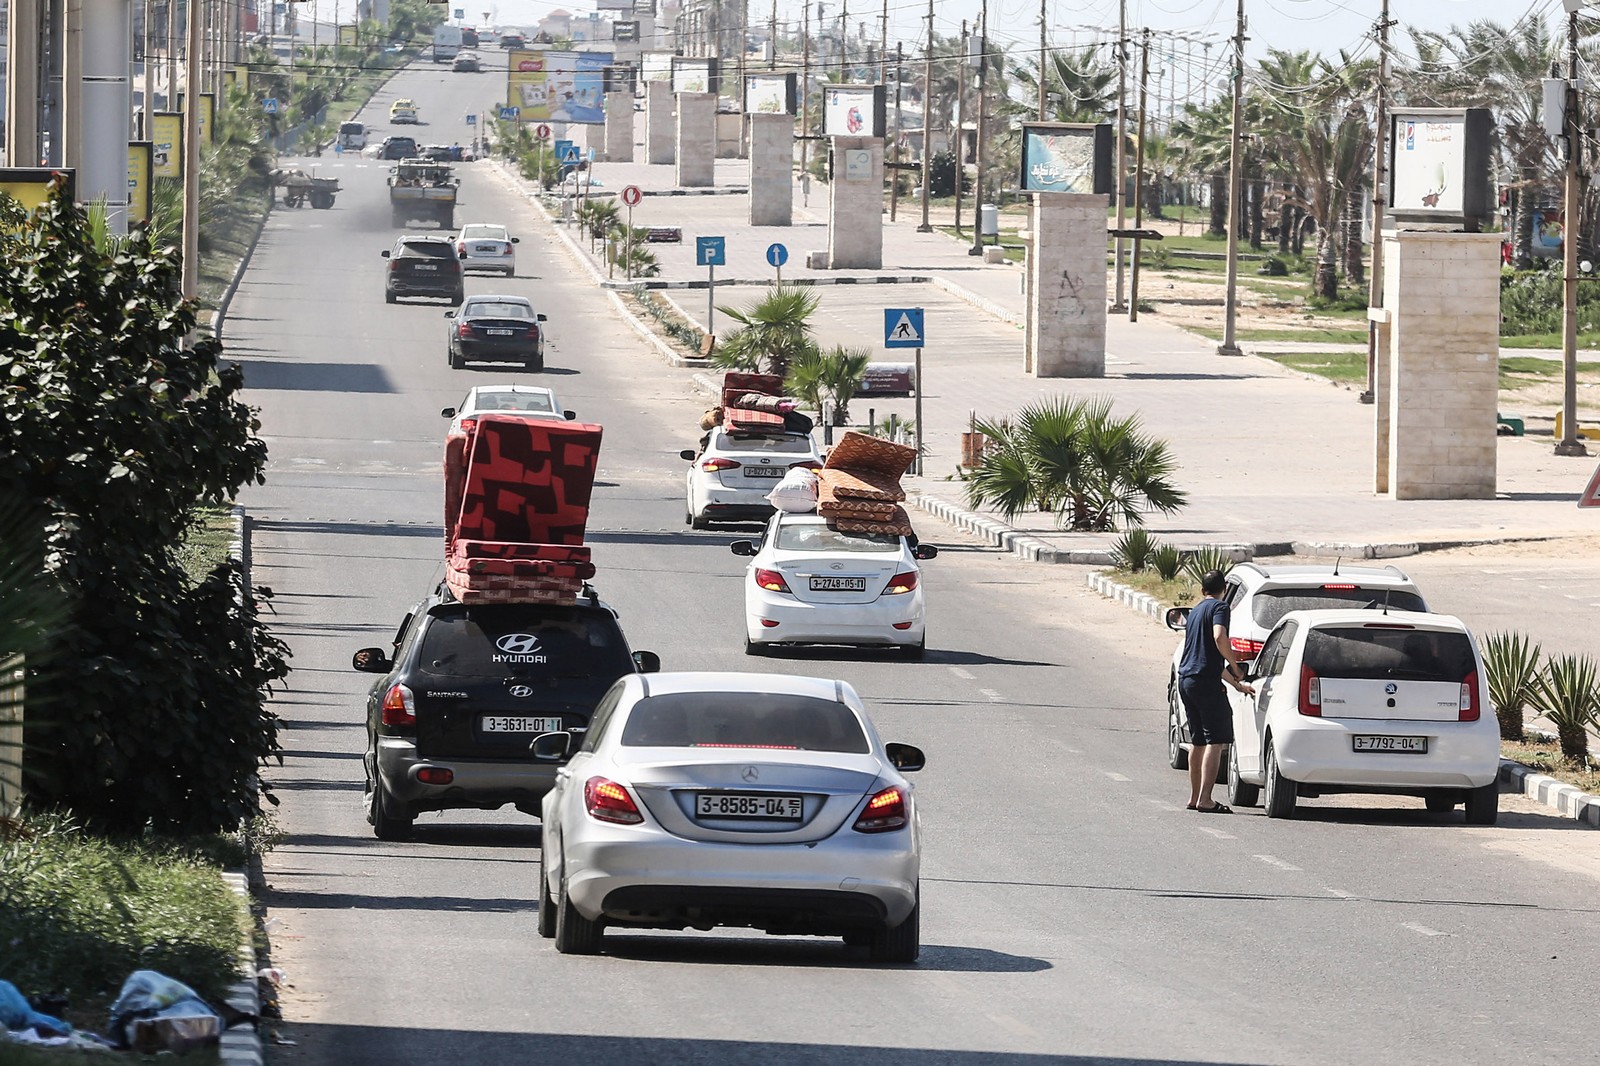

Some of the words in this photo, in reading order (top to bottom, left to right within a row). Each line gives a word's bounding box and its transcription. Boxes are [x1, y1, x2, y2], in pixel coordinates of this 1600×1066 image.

[705, 248, 716, 263] P
[492, 654, 547, 664] HYUNDAI
[702, 797, 785, 816] 3-8585-04
